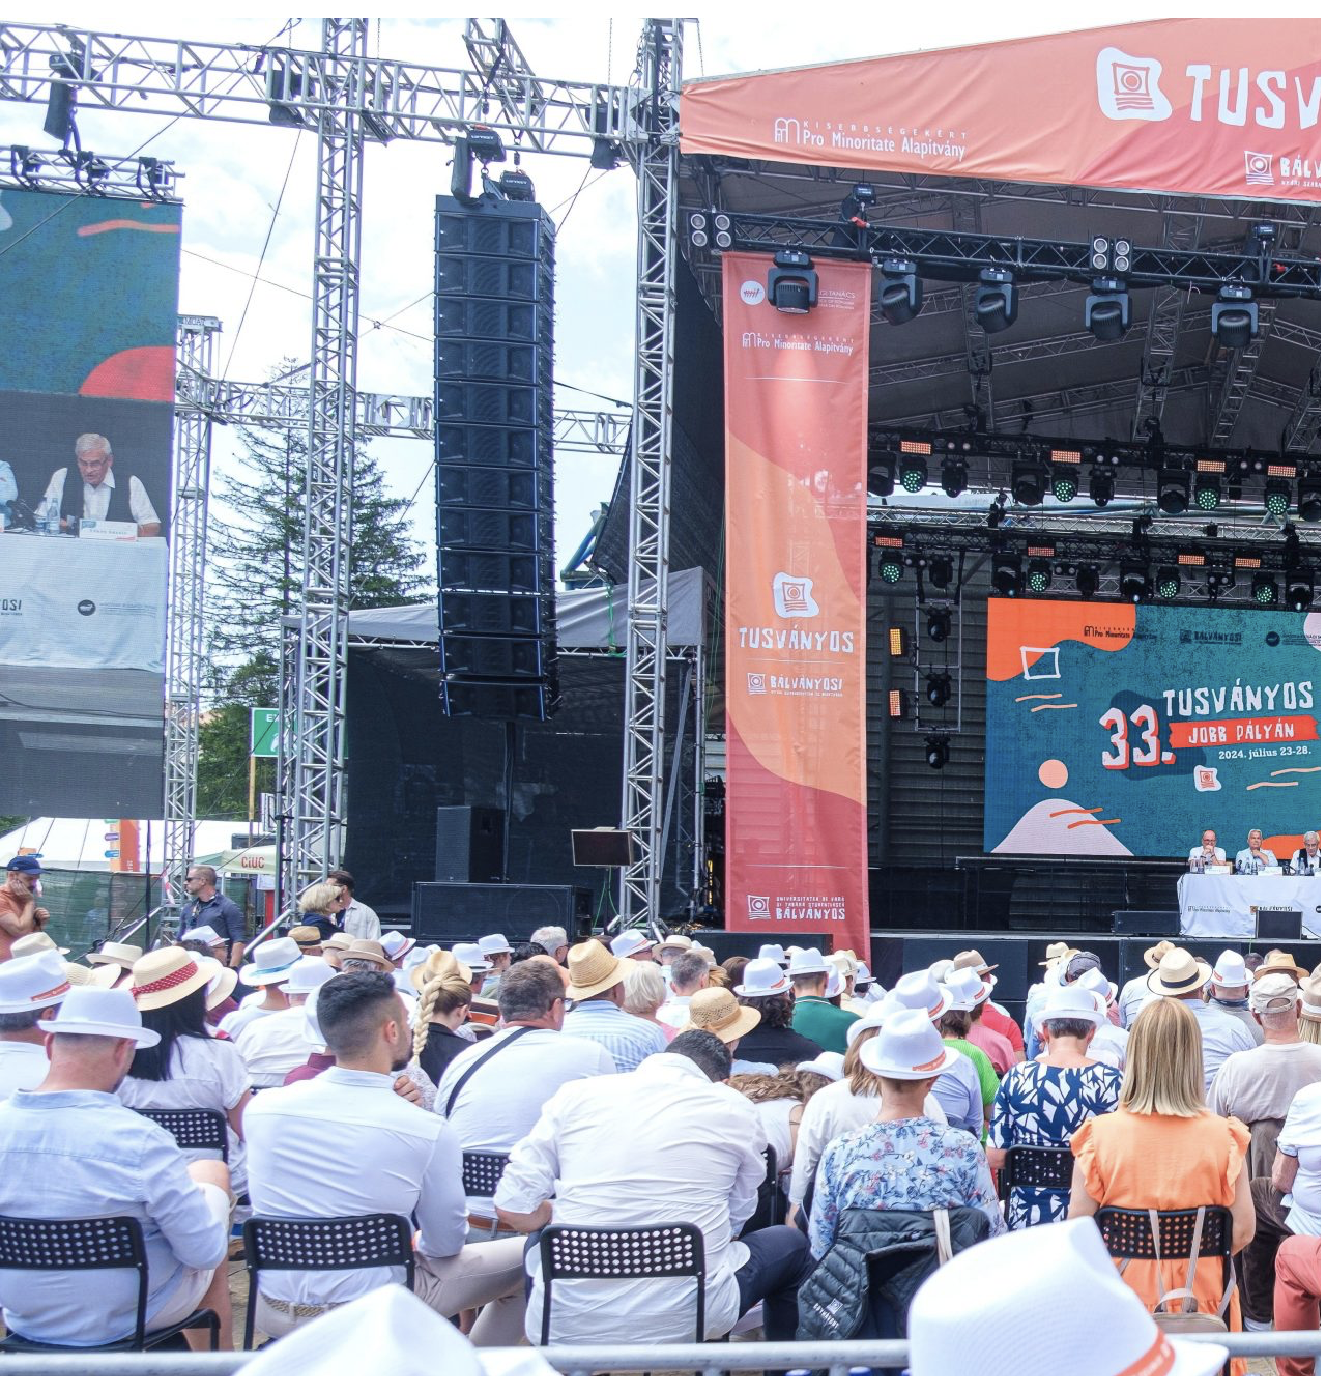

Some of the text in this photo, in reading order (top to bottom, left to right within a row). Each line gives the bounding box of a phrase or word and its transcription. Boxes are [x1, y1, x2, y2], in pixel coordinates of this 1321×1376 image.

[803, 129, 965, 162] Pro Minoritate Alapítvány
[757, 337, 770, 347] Pro
[814, 340, 854, 356] Alapítvány
[738, 624, 854, 653] TUSVÁNYOS
[770, 673, 842, 690] BÁLVÁNYOSI
[1162, 678, 1314, 716] TUSVÁNYOS
[1099, 704, 1176, 769] 33.
[1188, 718, 1294, 744] JOBB PÁLYÁN
[1218, 746, 1311, 761] 2024. július 23-28.
[776, 906, 846, 920] BÁLVÁNYOS
